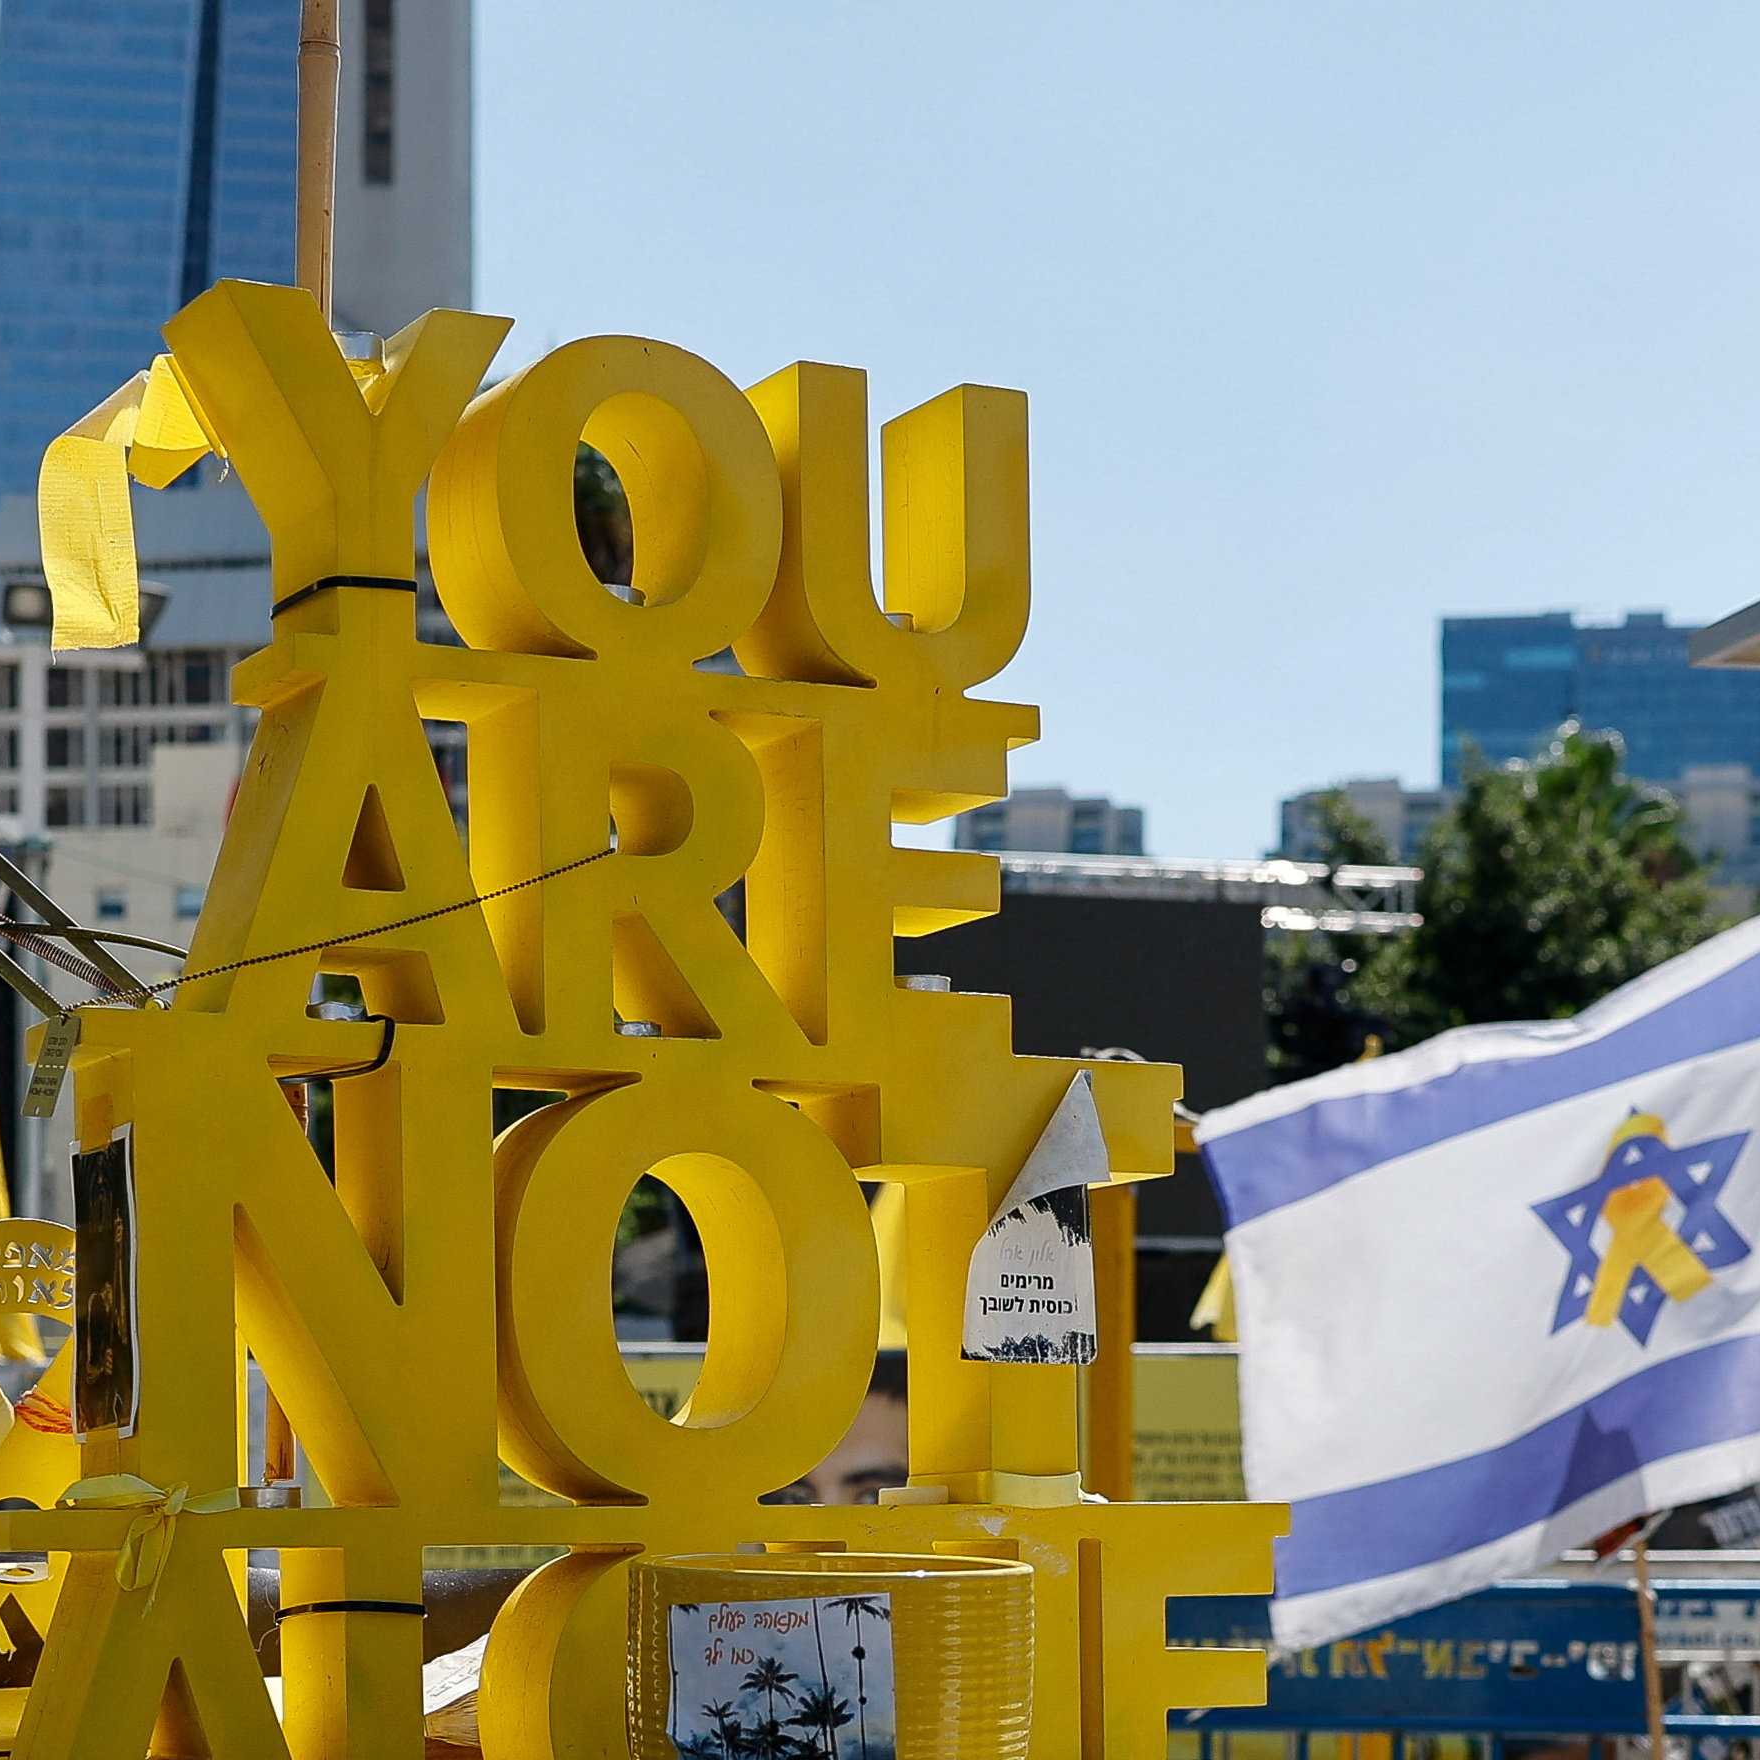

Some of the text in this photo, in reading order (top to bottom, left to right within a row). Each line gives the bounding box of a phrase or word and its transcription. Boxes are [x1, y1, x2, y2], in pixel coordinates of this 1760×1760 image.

[164, 278, 1029, 688] YOU
[189, 636, 1042, 1044] ARE
[65, 995, 1183, 1508] NOT
[1000, 1273, 1054, 1290] מרימים
[979, 1295, 1073, 1316] כוסית לשובך
[708, 1602, 746, 1633] בעולם
[704, 1637, 755, 1667] כמו ילד
